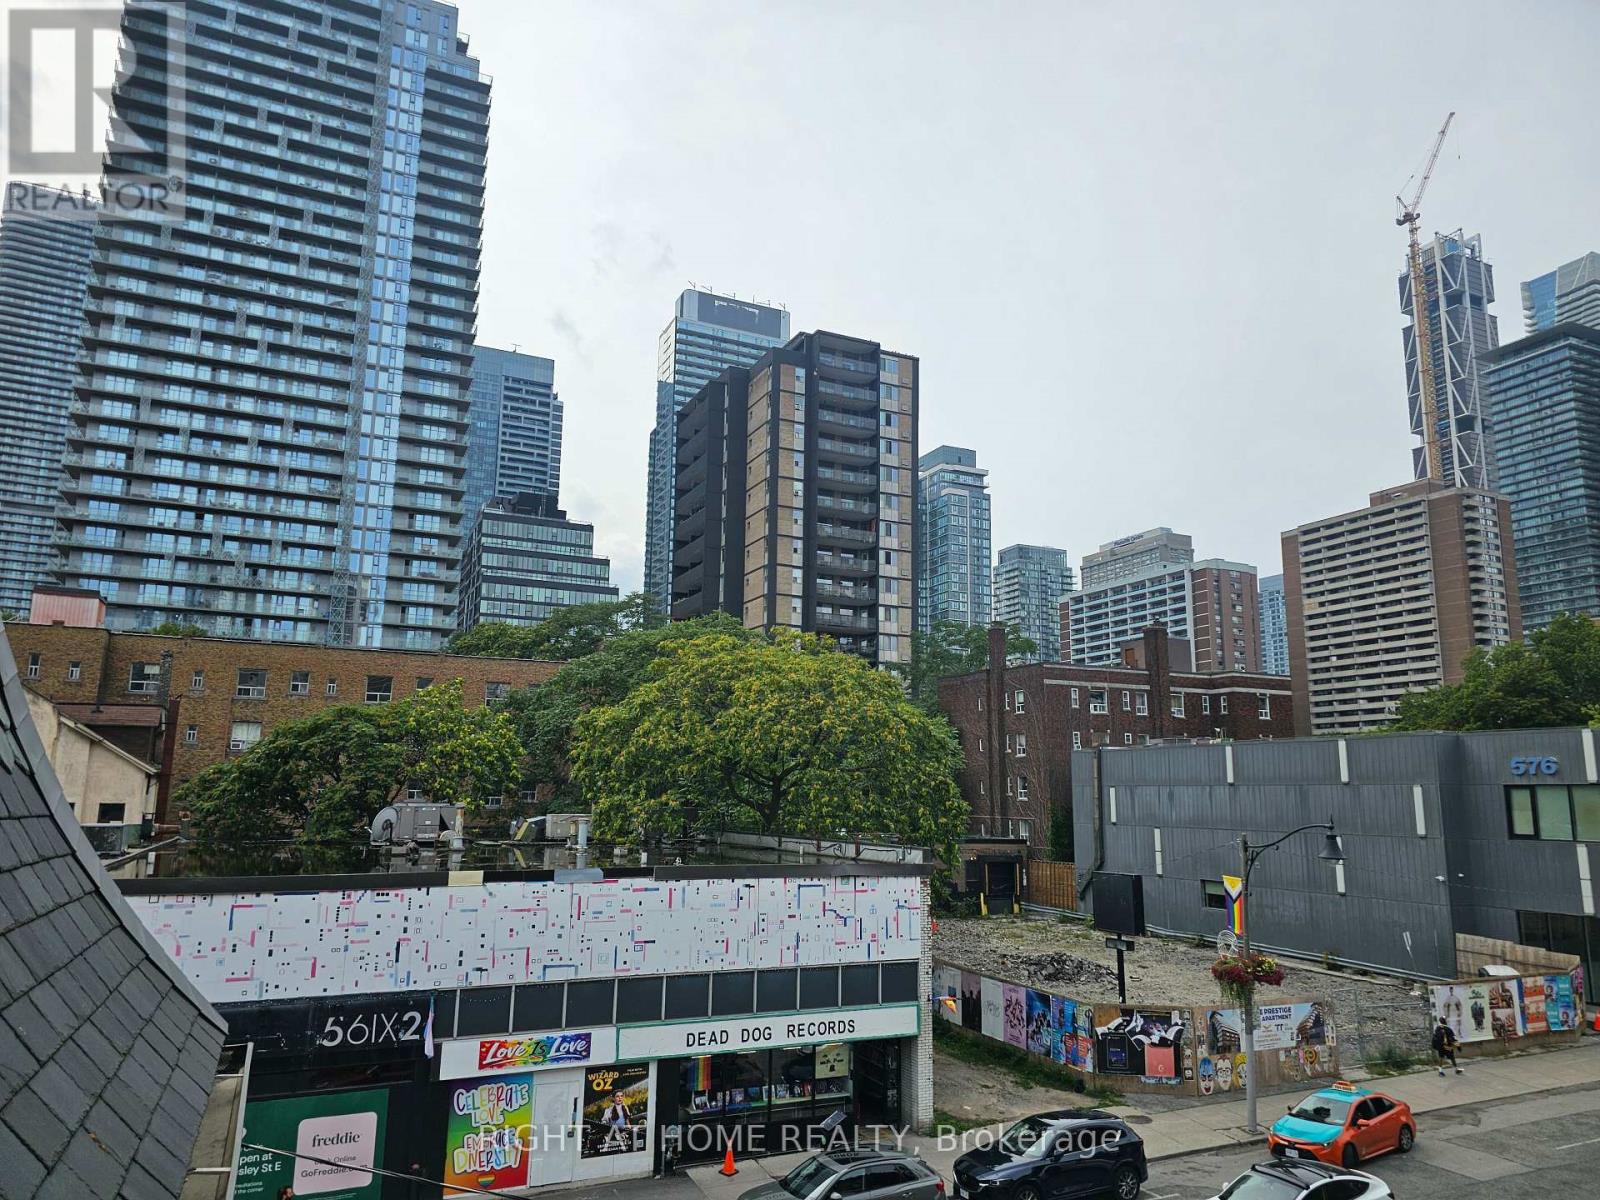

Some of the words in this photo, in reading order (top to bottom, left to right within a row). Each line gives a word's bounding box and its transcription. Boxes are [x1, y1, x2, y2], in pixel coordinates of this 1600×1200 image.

[1510, 757, 1559, 775] 576
[1263, 1006, 1292, 1015] PRESTIGE
[1261, 1014, 1292, 1022] APARTMENT
[686, 1030, 729, 1047] DEAD
[741, 1026, 772, 1043] DOG
[787, 1019, 856, 1038] RECORDS
[482, 1042, 527, 1064] Love
[529, 1041, 546, 1056] Is
[547, 1037, 588, 1058] Love
[587, 1071, 620, 1080] WIZARD
[592, 1079, 613, 1091] OZ
[473, 1103, 504, 1125] LOVE
[311, 1132, 360, 1148] freddie
[239, 1154, 260, 1166] pen
[262, 1153, 273, 1161] at
[261, 1163, 273, 1173] St
[274, 1161, 282, 1171] E
